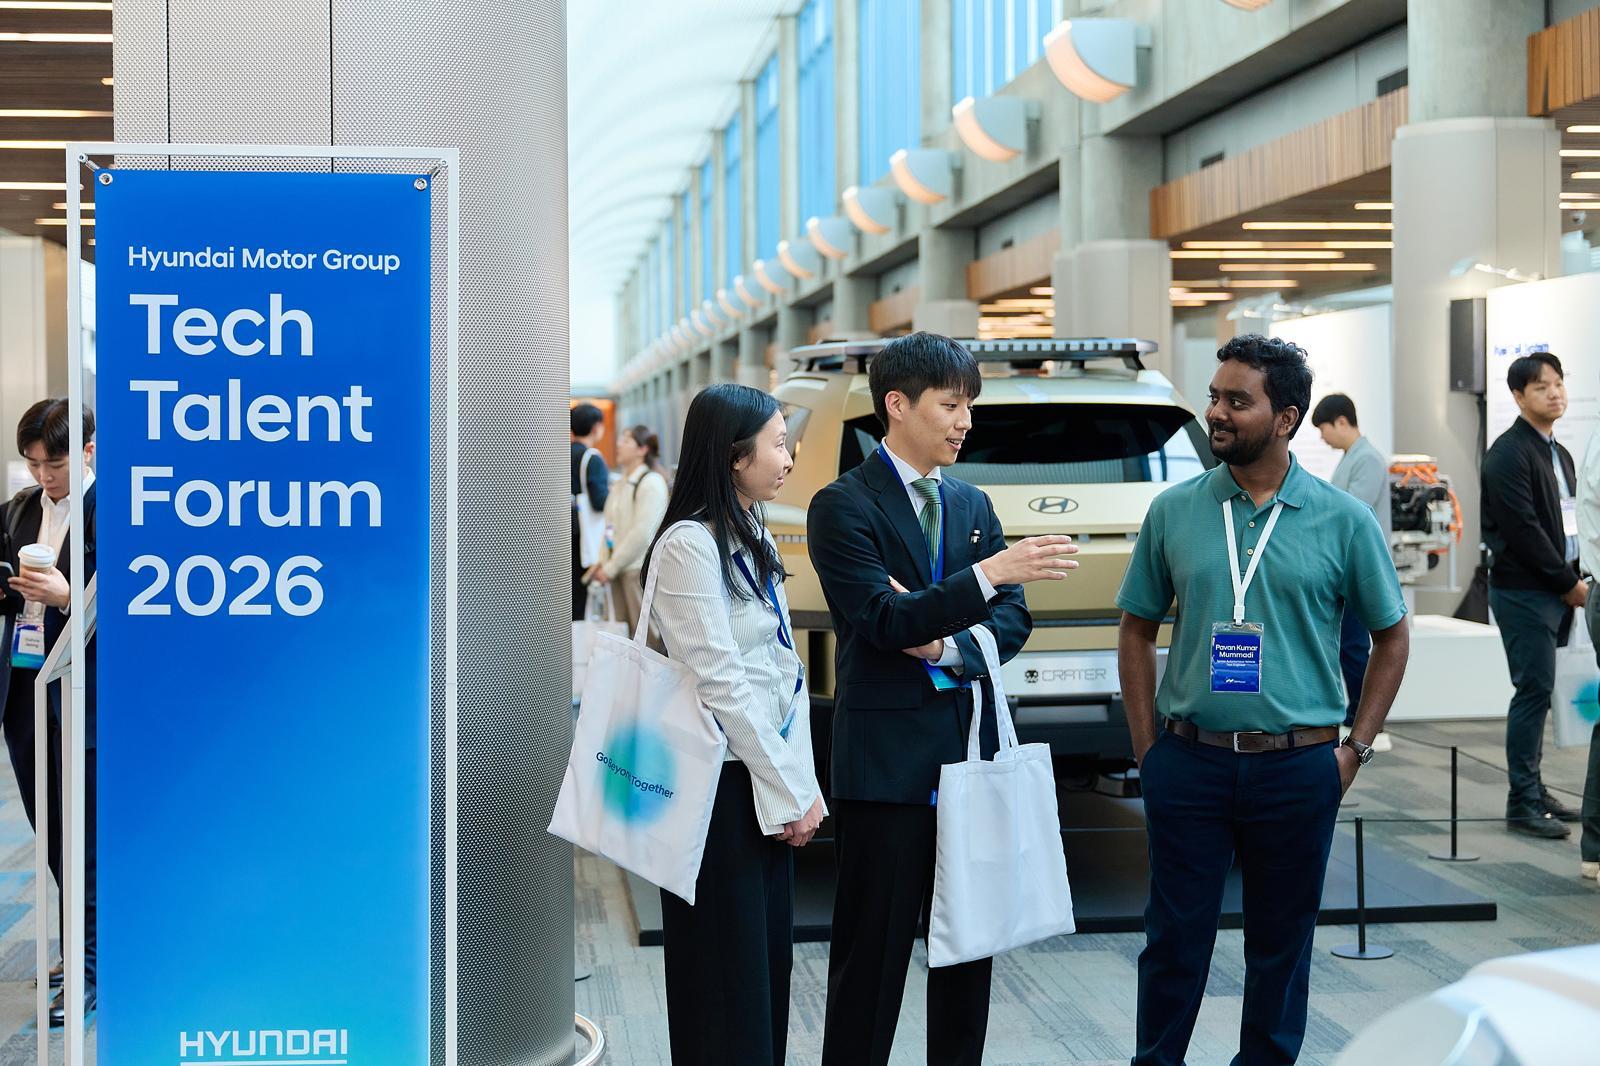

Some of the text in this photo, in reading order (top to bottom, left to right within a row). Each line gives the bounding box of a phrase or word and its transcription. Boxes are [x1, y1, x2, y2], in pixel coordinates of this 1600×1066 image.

[128, 246, 401, 275] Hyundai Motor Group
[129, 293, 313, 356] Tech
[129, 378, 373, 443] Talent
[131, 466, 382, 528] Forum
[127, 554, 324, 617] 2026
[1041, 668, 1107, 682] CRATER
[596, 751, 609, 765] Go
[630, 775, 674, 799] Together
[180, 1029, 348, 1057] HYUNDAI
